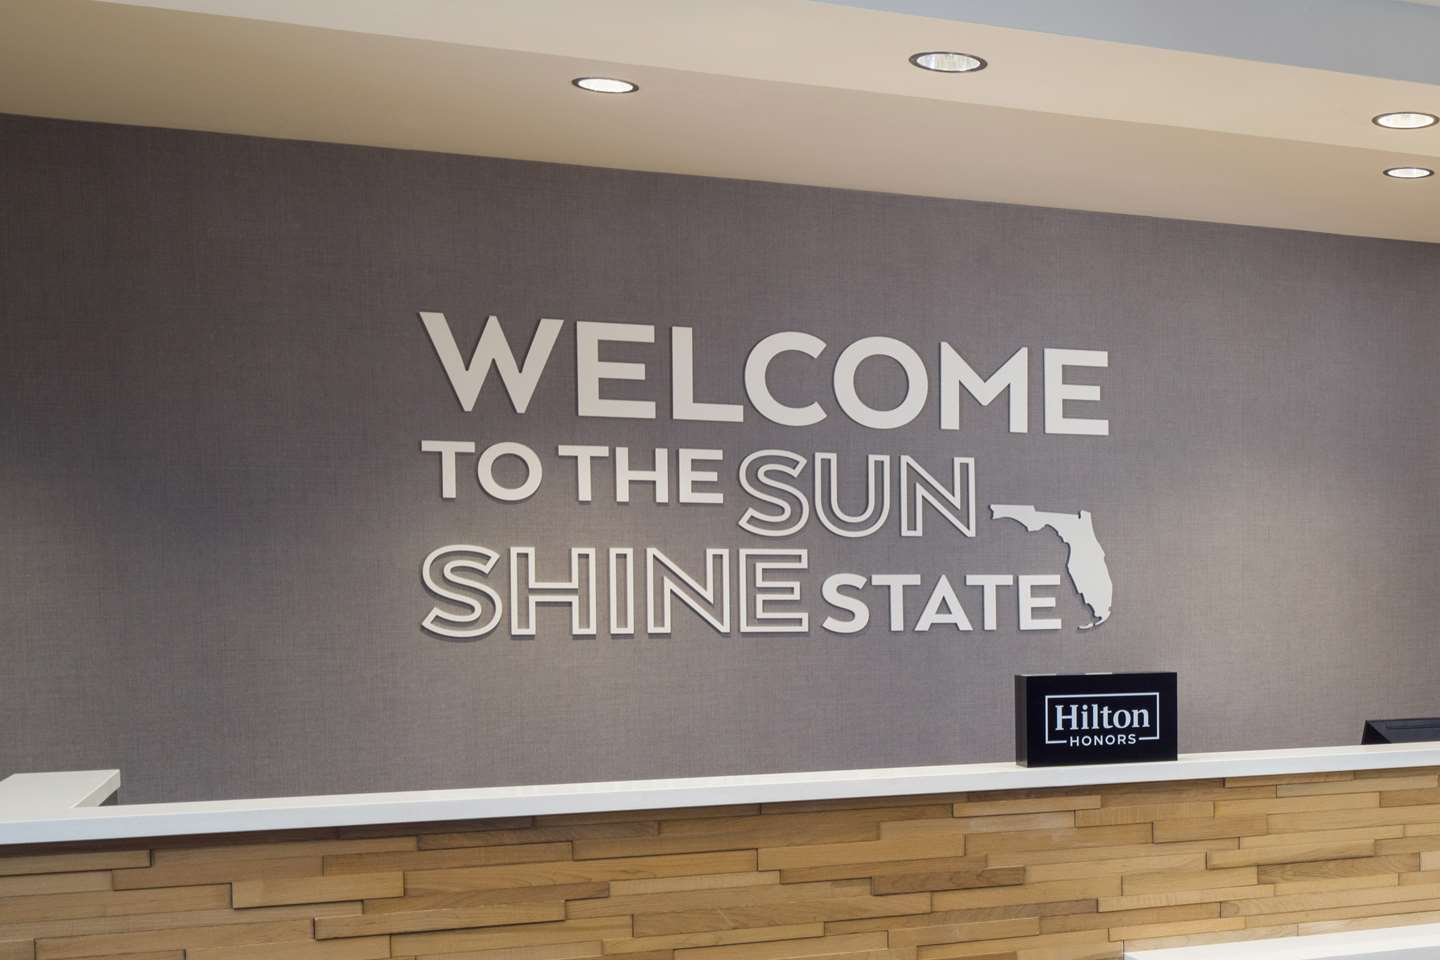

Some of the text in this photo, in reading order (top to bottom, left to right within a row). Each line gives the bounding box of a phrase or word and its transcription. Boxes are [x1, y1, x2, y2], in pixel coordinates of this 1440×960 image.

[419, 311, 1110, 436] WELCOME
[421, 440, 977, 538] TO THE SUN
[421, 544, 1063, 638] SHINE STATE
[1055, 703, 1151, 731] Hilton
[1069, 733, 1137, 747] HONORS
